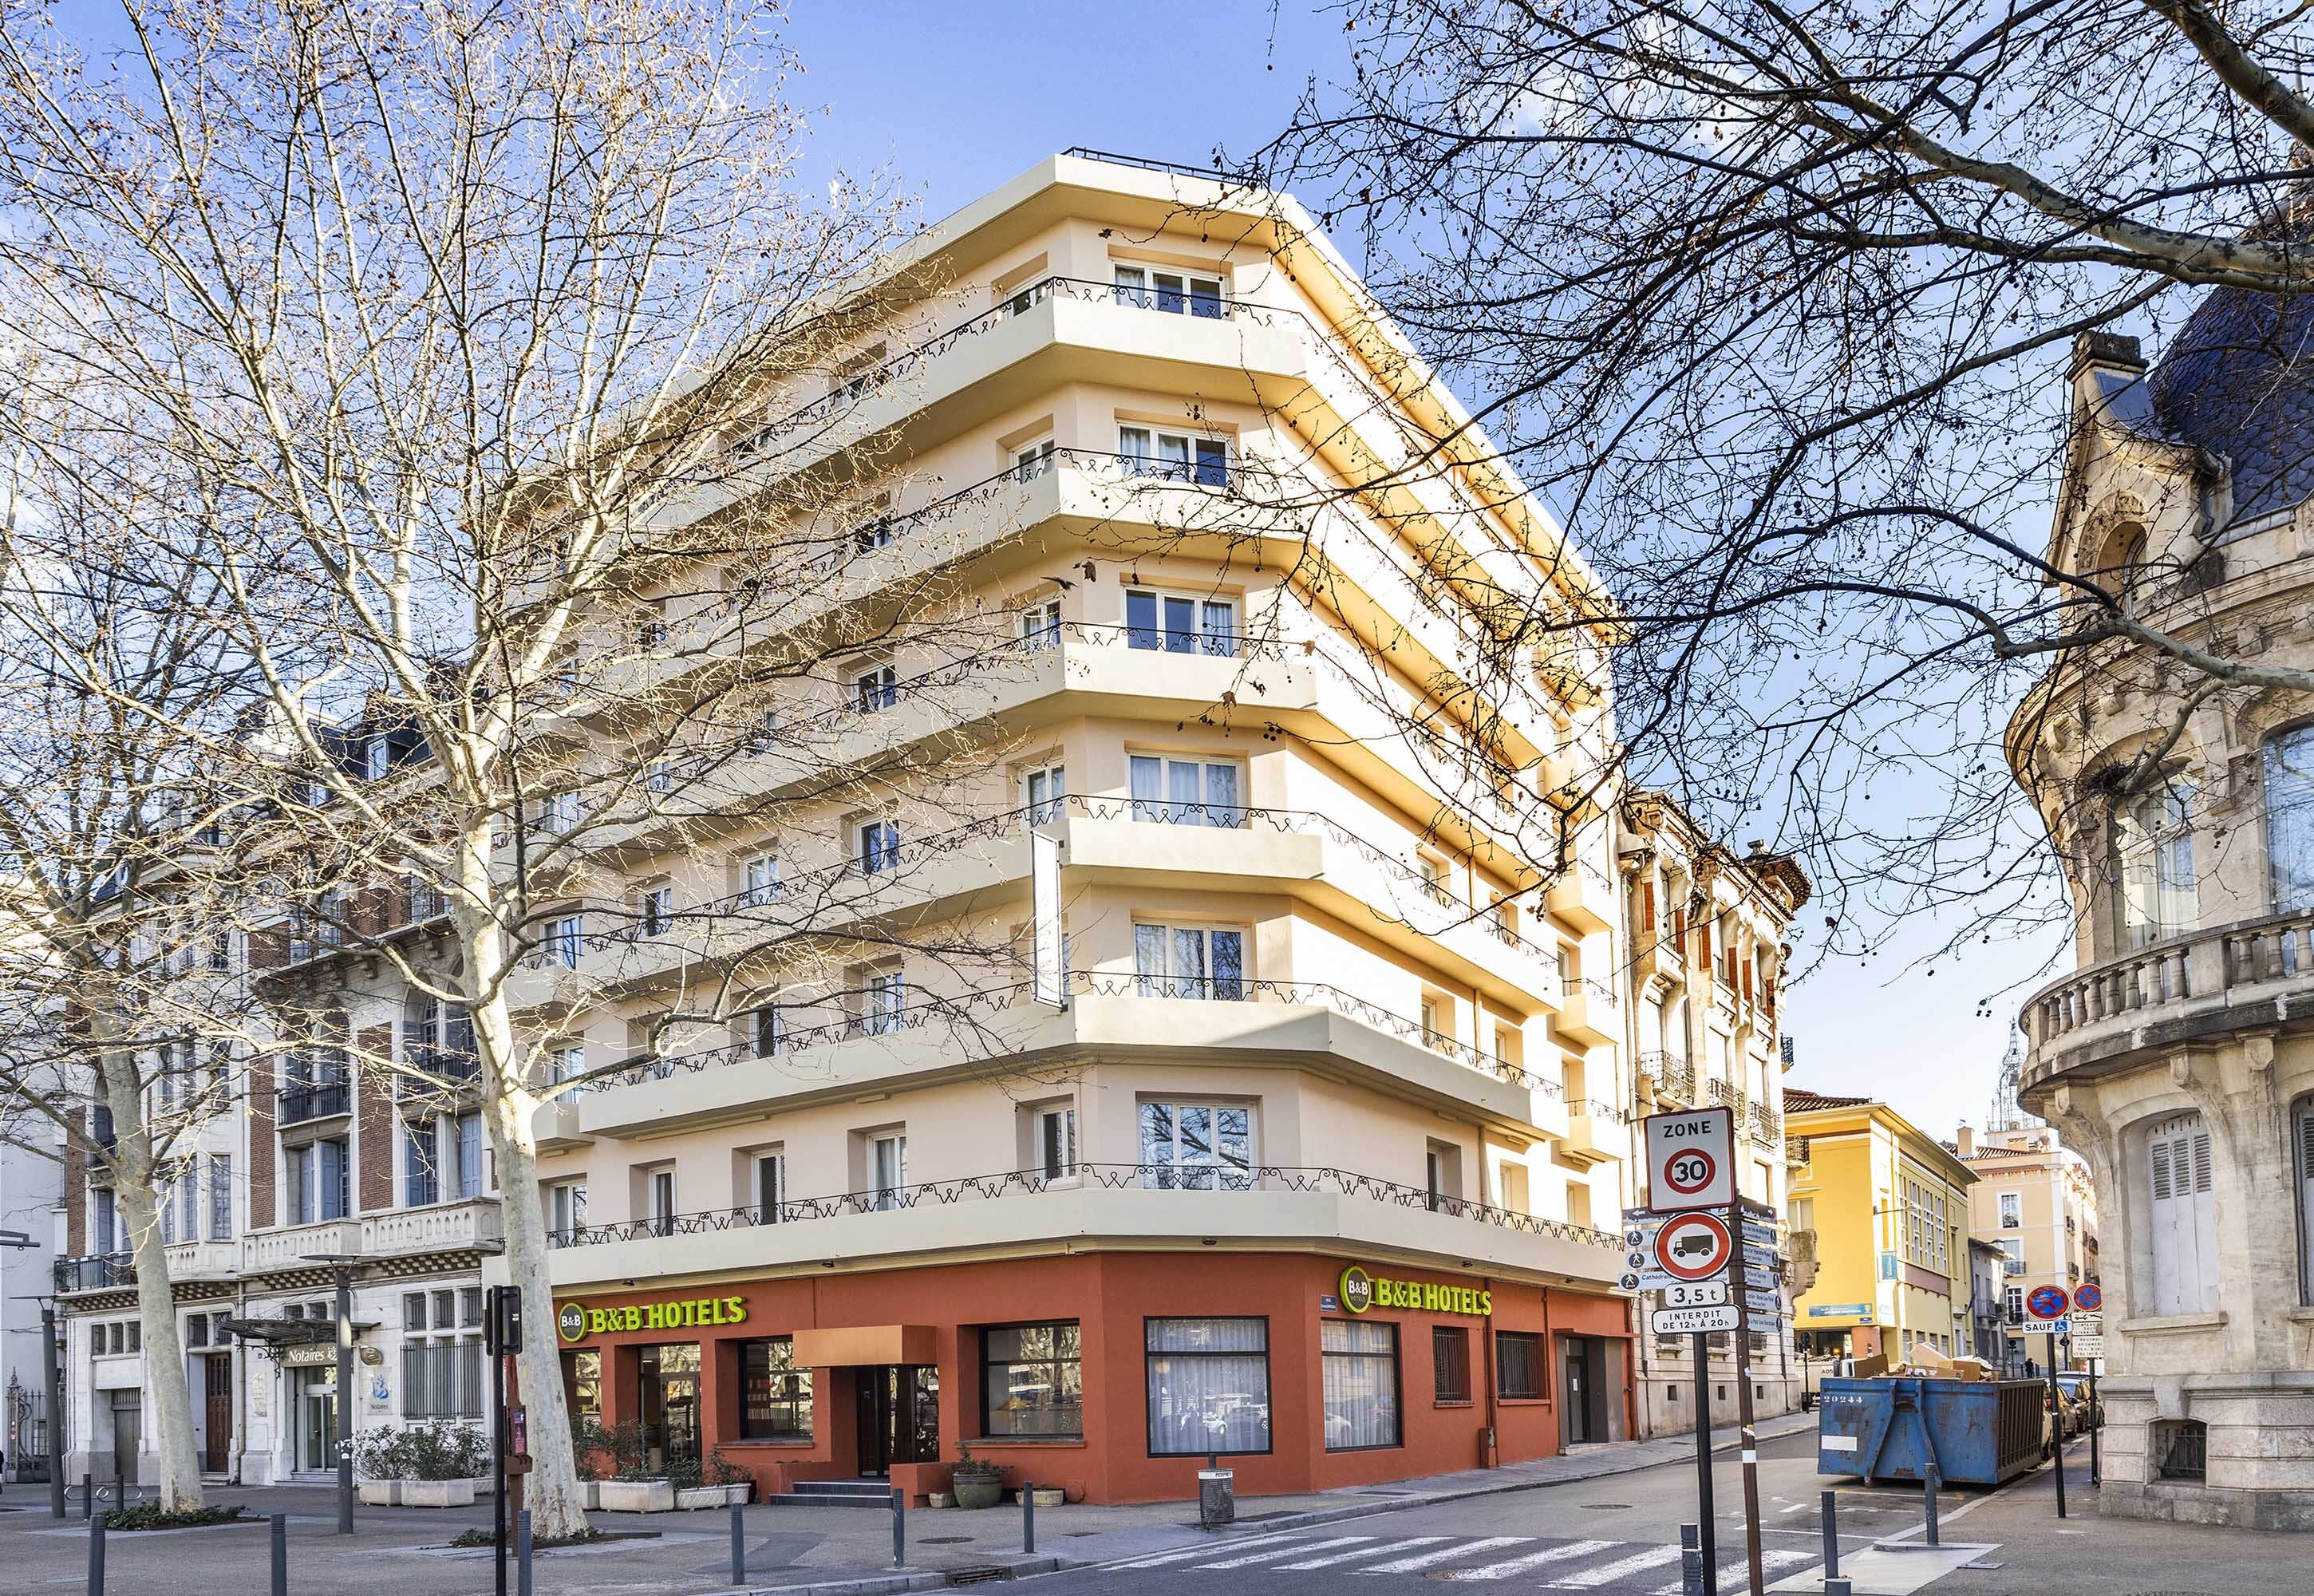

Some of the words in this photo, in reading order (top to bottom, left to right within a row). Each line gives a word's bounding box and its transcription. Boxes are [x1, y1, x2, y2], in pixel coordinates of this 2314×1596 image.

[1663, 1120, 1712, 1139] ZONE
[1673, 1160, 1707, 1183] 30
[1348, 1279, 1368, 1296] B&B
[1375, 1278, 1422, 1309] B&B
[1423, 1282, 1492, 1316] HOTELS
[1674, 1287, 1704, 1305] 3,5
[1711, 1290, 1717, 1301] t
[561, 1314, 582, 1327] B&B
[592, 1306, 642, 1333] B&B
[649, 1296, 747, 1329] HOTELS
[1669, 1310, 1721, 1321] INTERDIT
[1663, 1321, 1675, 1329] DE
[1680, 1320, 1696, 1329] 12h
[1700, 1317, 1707, 1328] À
[1711, 1318, 1729, 1327] 20h
[2025, 1322, 2053, 1332] SAUF
[288, 1348, 325, 1363] Notaires
[1823, 1395, 1863, 1404] 20244
